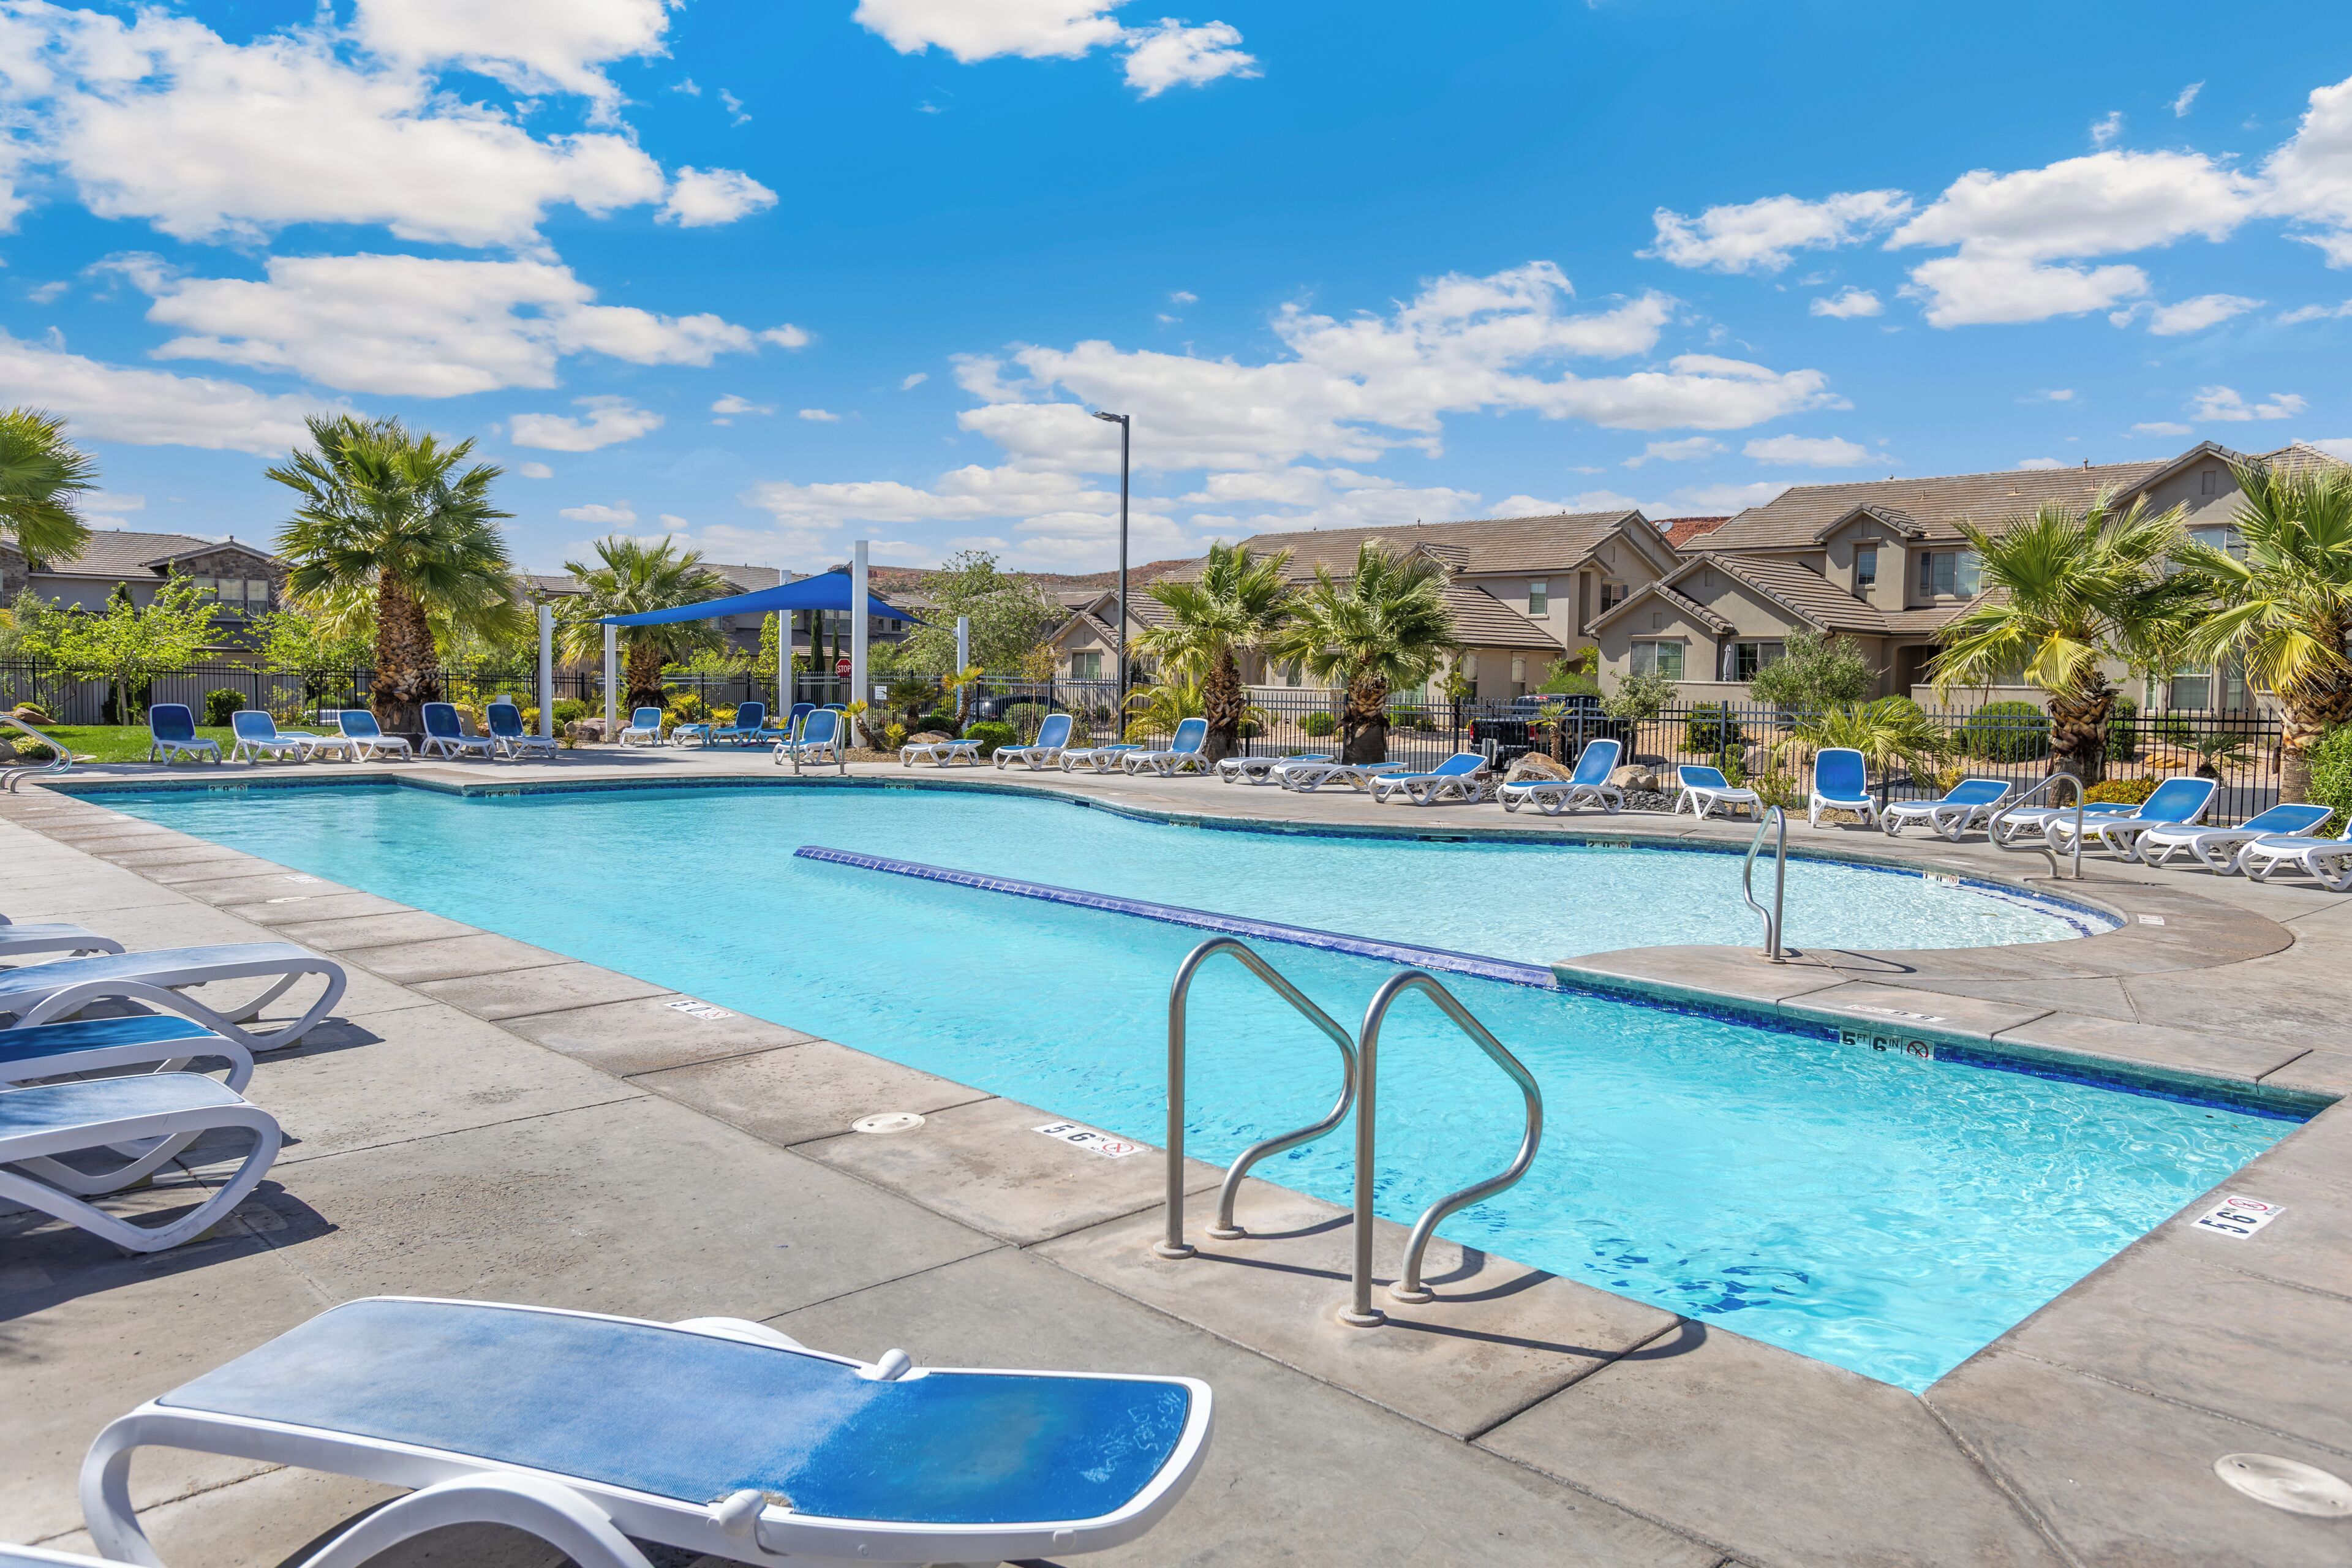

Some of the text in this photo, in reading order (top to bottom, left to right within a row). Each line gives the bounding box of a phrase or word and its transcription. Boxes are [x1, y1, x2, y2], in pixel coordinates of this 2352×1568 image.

[1842, 1031, 1899, 1052] 5 FT 6 IN
[1043, 1125, 1076, 1133] 5
[1067, 1133, 1096, 1141] 6
[2216, 1212, 2257, 1224] 6
[2198, 1219, 2250, 1234] 5
